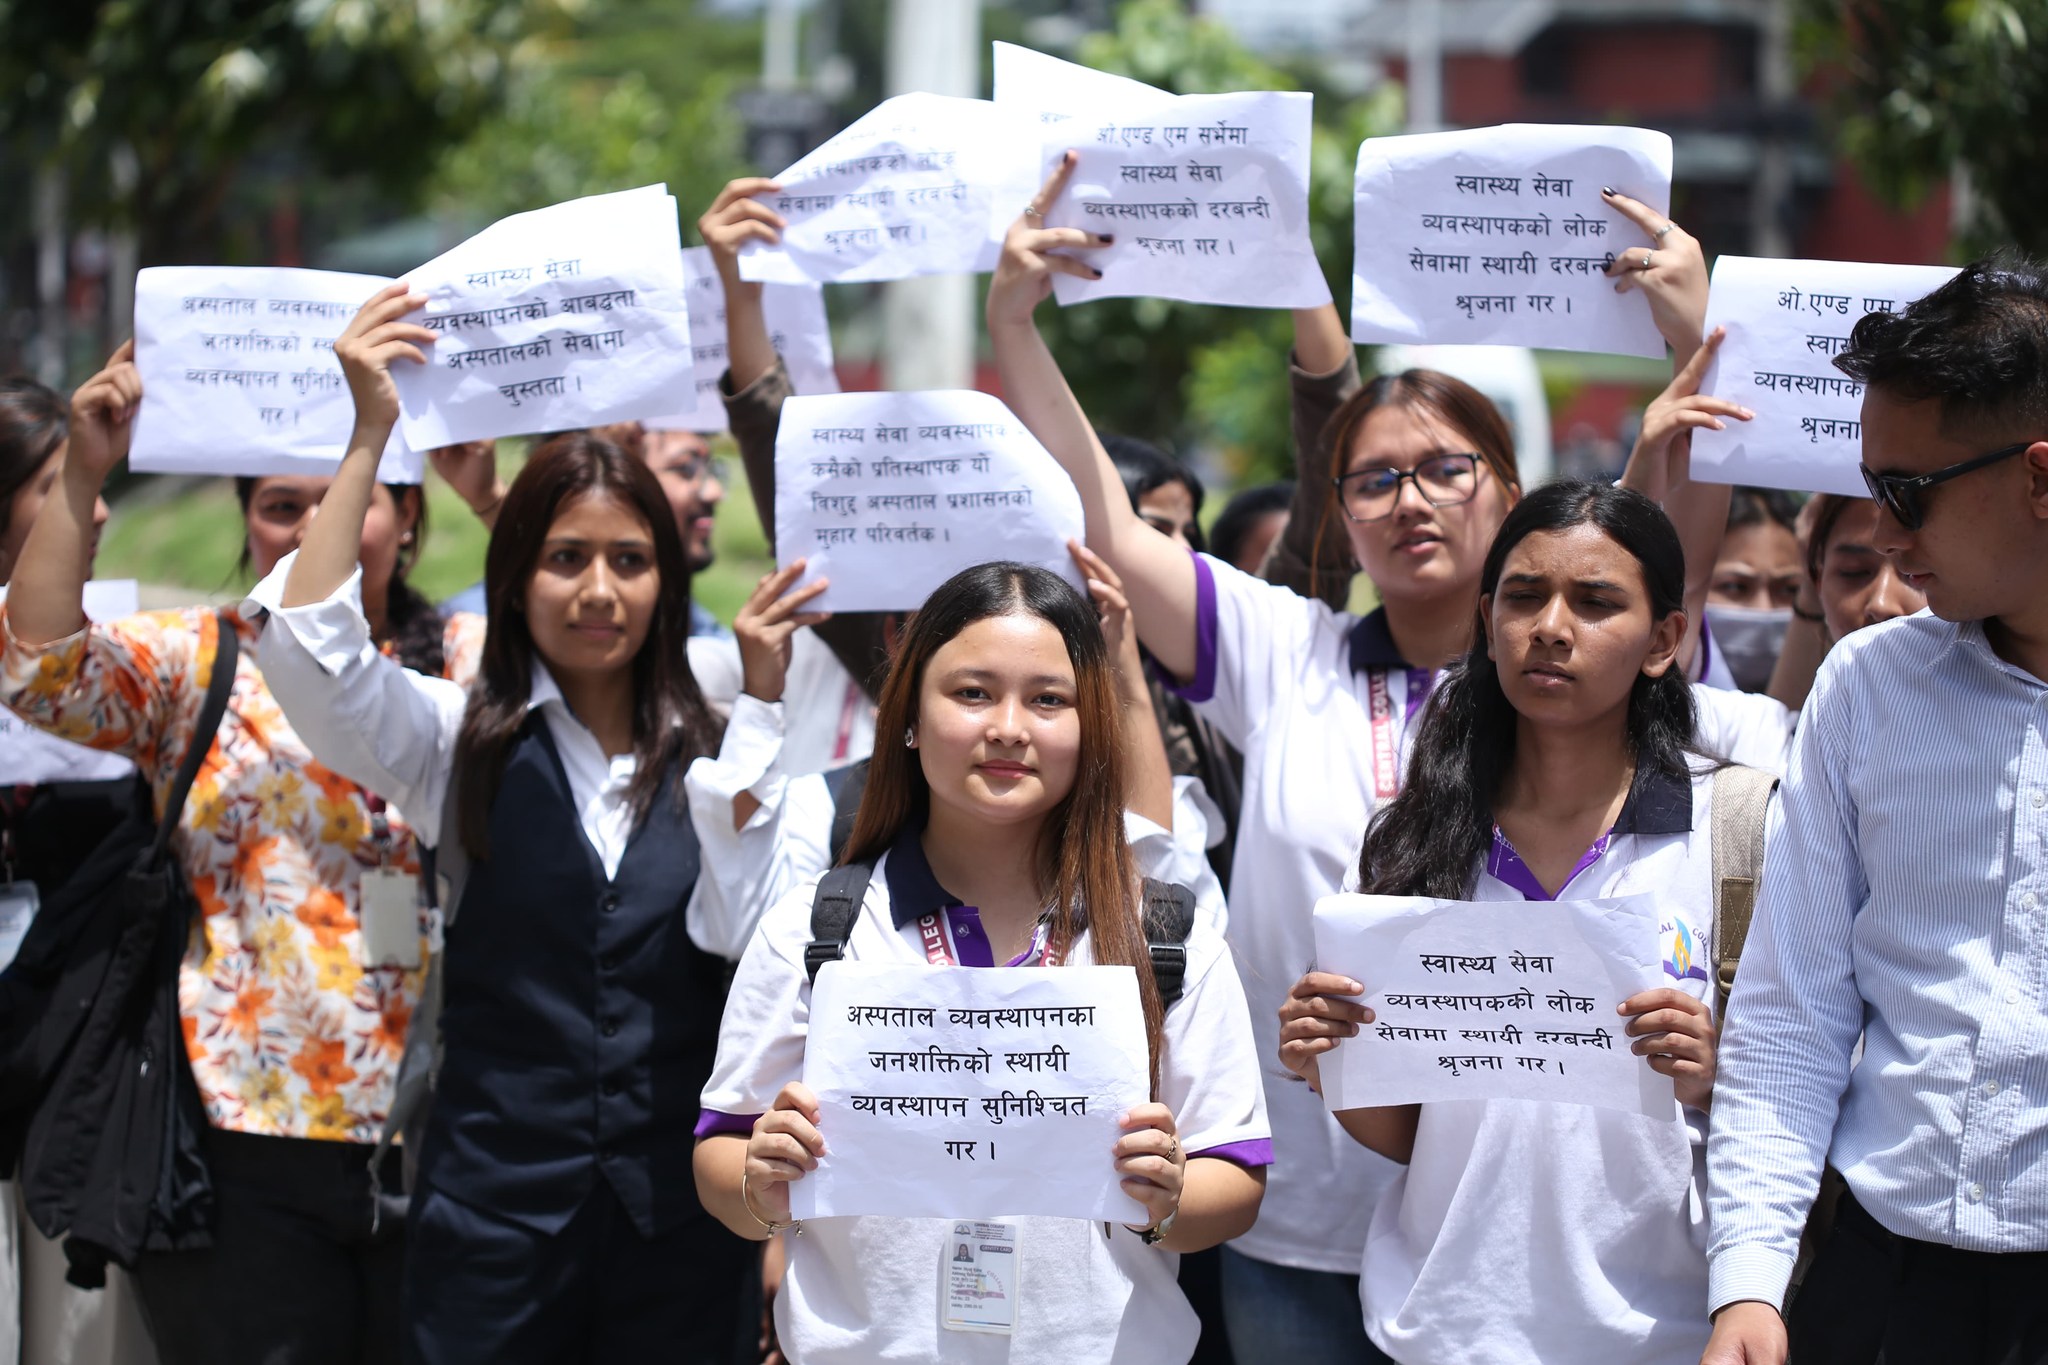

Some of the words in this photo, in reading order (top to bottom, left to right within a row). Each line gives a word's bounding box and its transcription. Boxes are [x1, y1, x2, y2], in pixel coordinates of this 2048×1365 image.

[1164, 127, 1189, 147] एम
[1120, 165, 1177, 183] स्वास्थ्य
[1187, 160, 1222, 182] सेवा
[1454, 175, 1521, 197] स्वास्थ्य
[1532, 172, 1573, 197] सेवा
[1082, 197, 1199, 219] व्यवस्थापकको
[1207, 196, 1270, 219] दरबन्दी
[1421, 212, 1552, 237] व्यवस्थापकको
[1562, 213, 1608, 237] लोक
[1193, 239, 1219, 255] गर
[465, 266, 534, 288] स्वास्थ्य
[544, 258, 581, 279] सेवा
[1408, 247, 1470, 274] सेवामा
[1481, 251, 1538, 275] स्थायी
[181, 296, 258, 315] अस्पताल
[1527, 295, 1555, 313] गर
[1777, 285, 1852, 316] ओ.एण्ड
[423, 297, 548, 331] व्यवस्थापनको
[447, 337, 552, 370] अस्पतालको
[562, 329, 624, 351] सेवामा
[185, 368, 280, 388] व्यवस्थापन
[498, 376, 566, 406] चुस्तता
[1754, 371, 1862, 399] व्यवस्थापक
[259, 407, 285, 425] गर
[811, 428, 865, 443] स्वास्थ्य
[874, 422, 909, 442] सेवा
[811, 455, 862, 478] कसैको
[871, 456, 962, 478] प्रतिस्थापक
[970, 452, 991, 473] यो
[867, 494, 937, 511] अस्पताल
[946, 485, 1032, 509] प्रशासनको
[814, 527, 857, 550] मुहार
[866, 522, 935, 543] परिवर्तक
[1419, 953, 1497, 975] स्वास्थ्य
[1508, 949, 1554, 974] सेवा
[1384, 987, 1535, 1011] व्यवस्थापकको
[1546, 989, 1595, 1014] लोक
[847, 1005, 936, 1027] अस्पताल
[948, 1005, 1096, 1028] व्यवस्थापनका
[1375, 1021, 1447, 1042] सेवामा
[1459, 1023, 1522, 1045] स्थायी
[1534, 1027, 1614, 1051] दरबन्दी
[868, 1044, 992, 1074] जनशक्तिको
[1004, 1043, 1071, 1073] स्थायी
[1516, 1056, 1547, 1074] गर
[851, 1094, 969, 1117] व्यवस्थापन
[980, 1090, 1089, 1124] सुनिश्चित
[944, 1140, 977, 1161] गर
